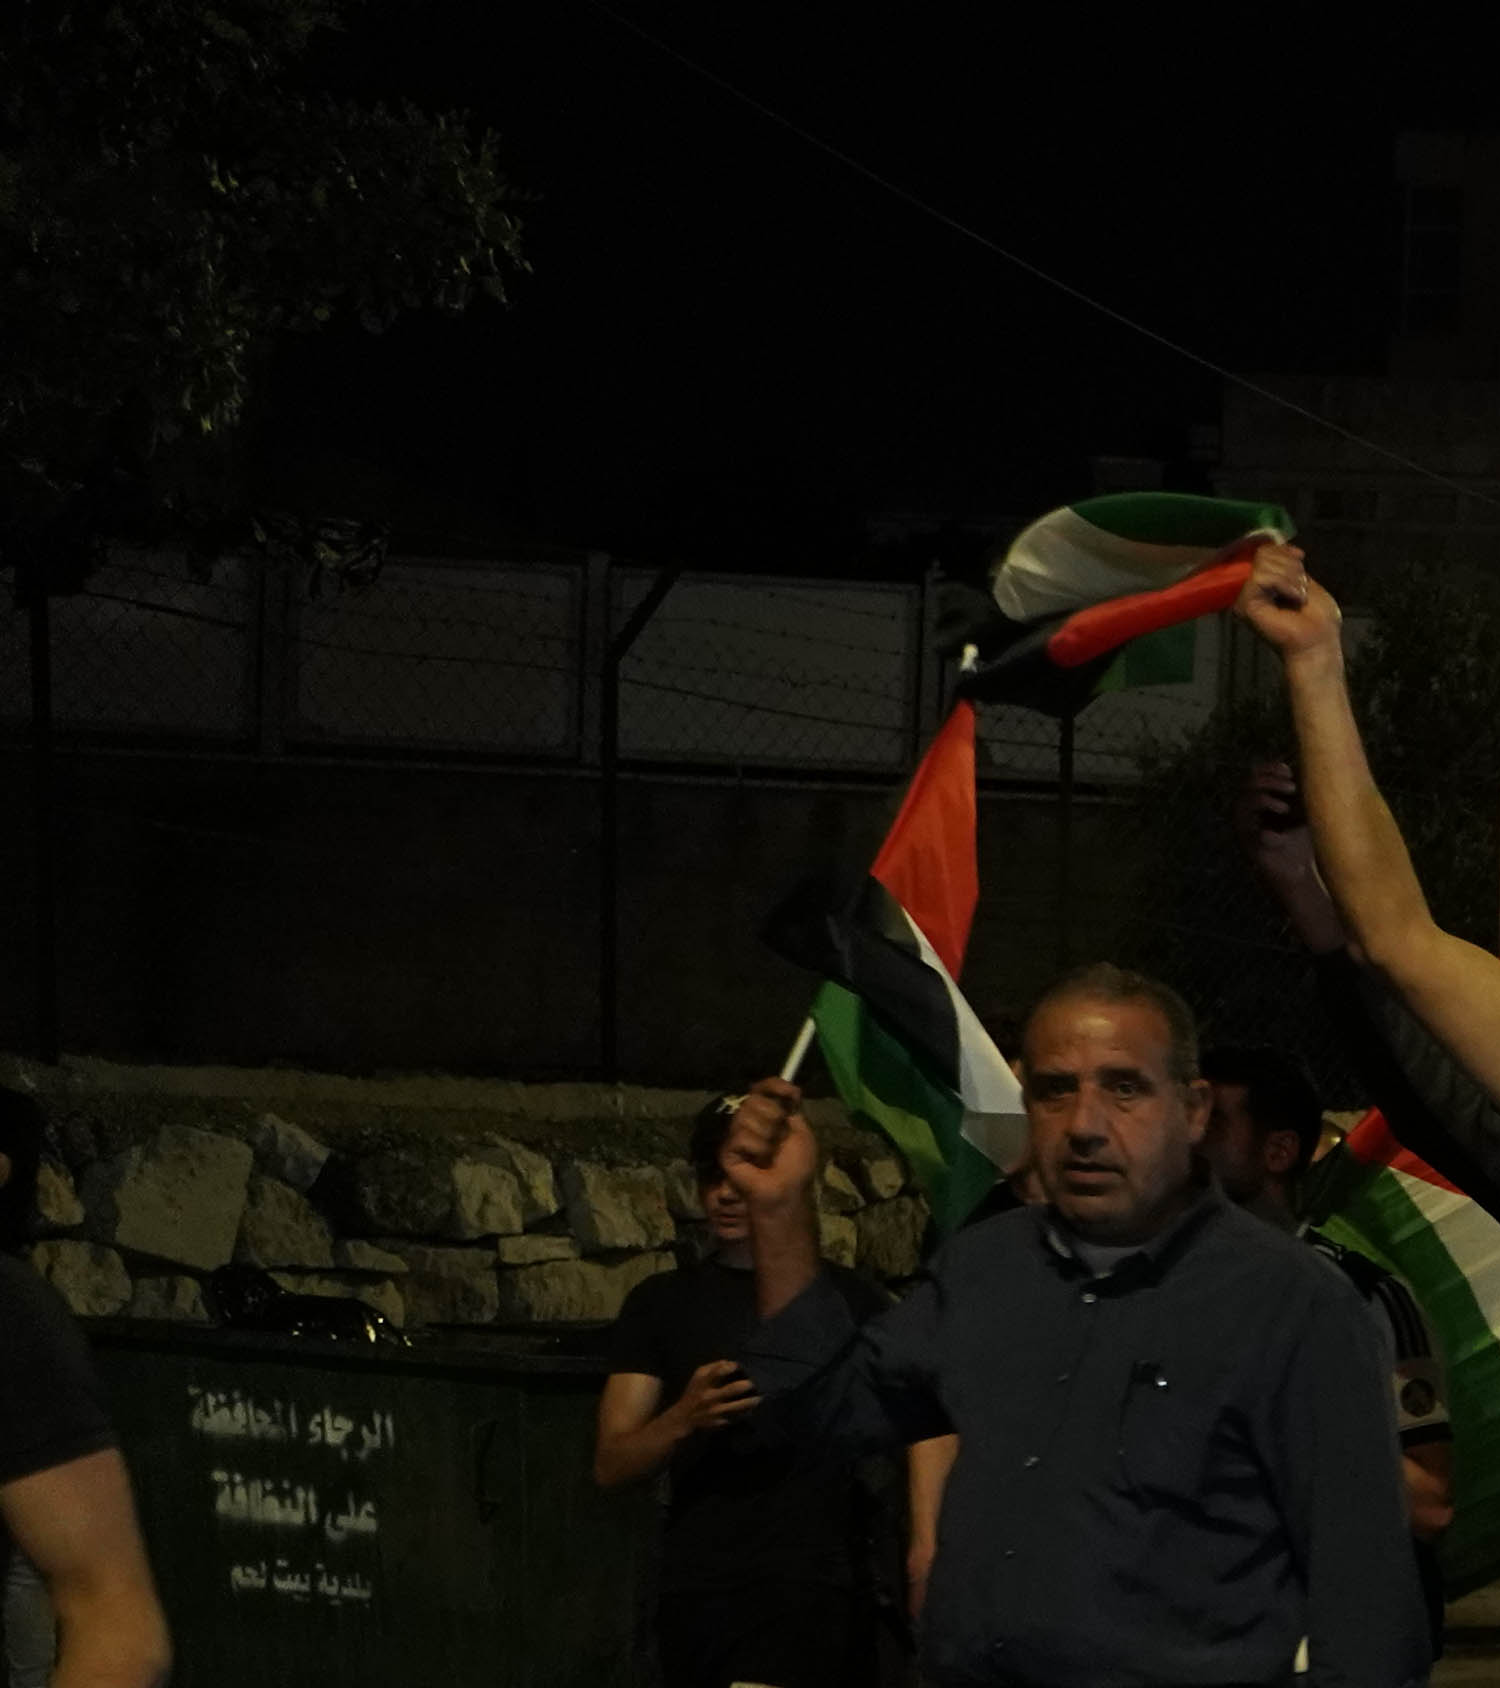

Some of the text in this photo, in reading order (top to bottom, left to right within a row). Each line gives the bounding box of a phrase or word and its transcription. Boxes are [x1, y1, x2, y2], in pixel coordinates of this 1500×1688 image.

[187, 1384, 395, 1461] الرجاء المحافظة
[211, 1469, 378, 1544] على النظافة
[230, 1558, 373, 1608] بلدية بيت لحم
